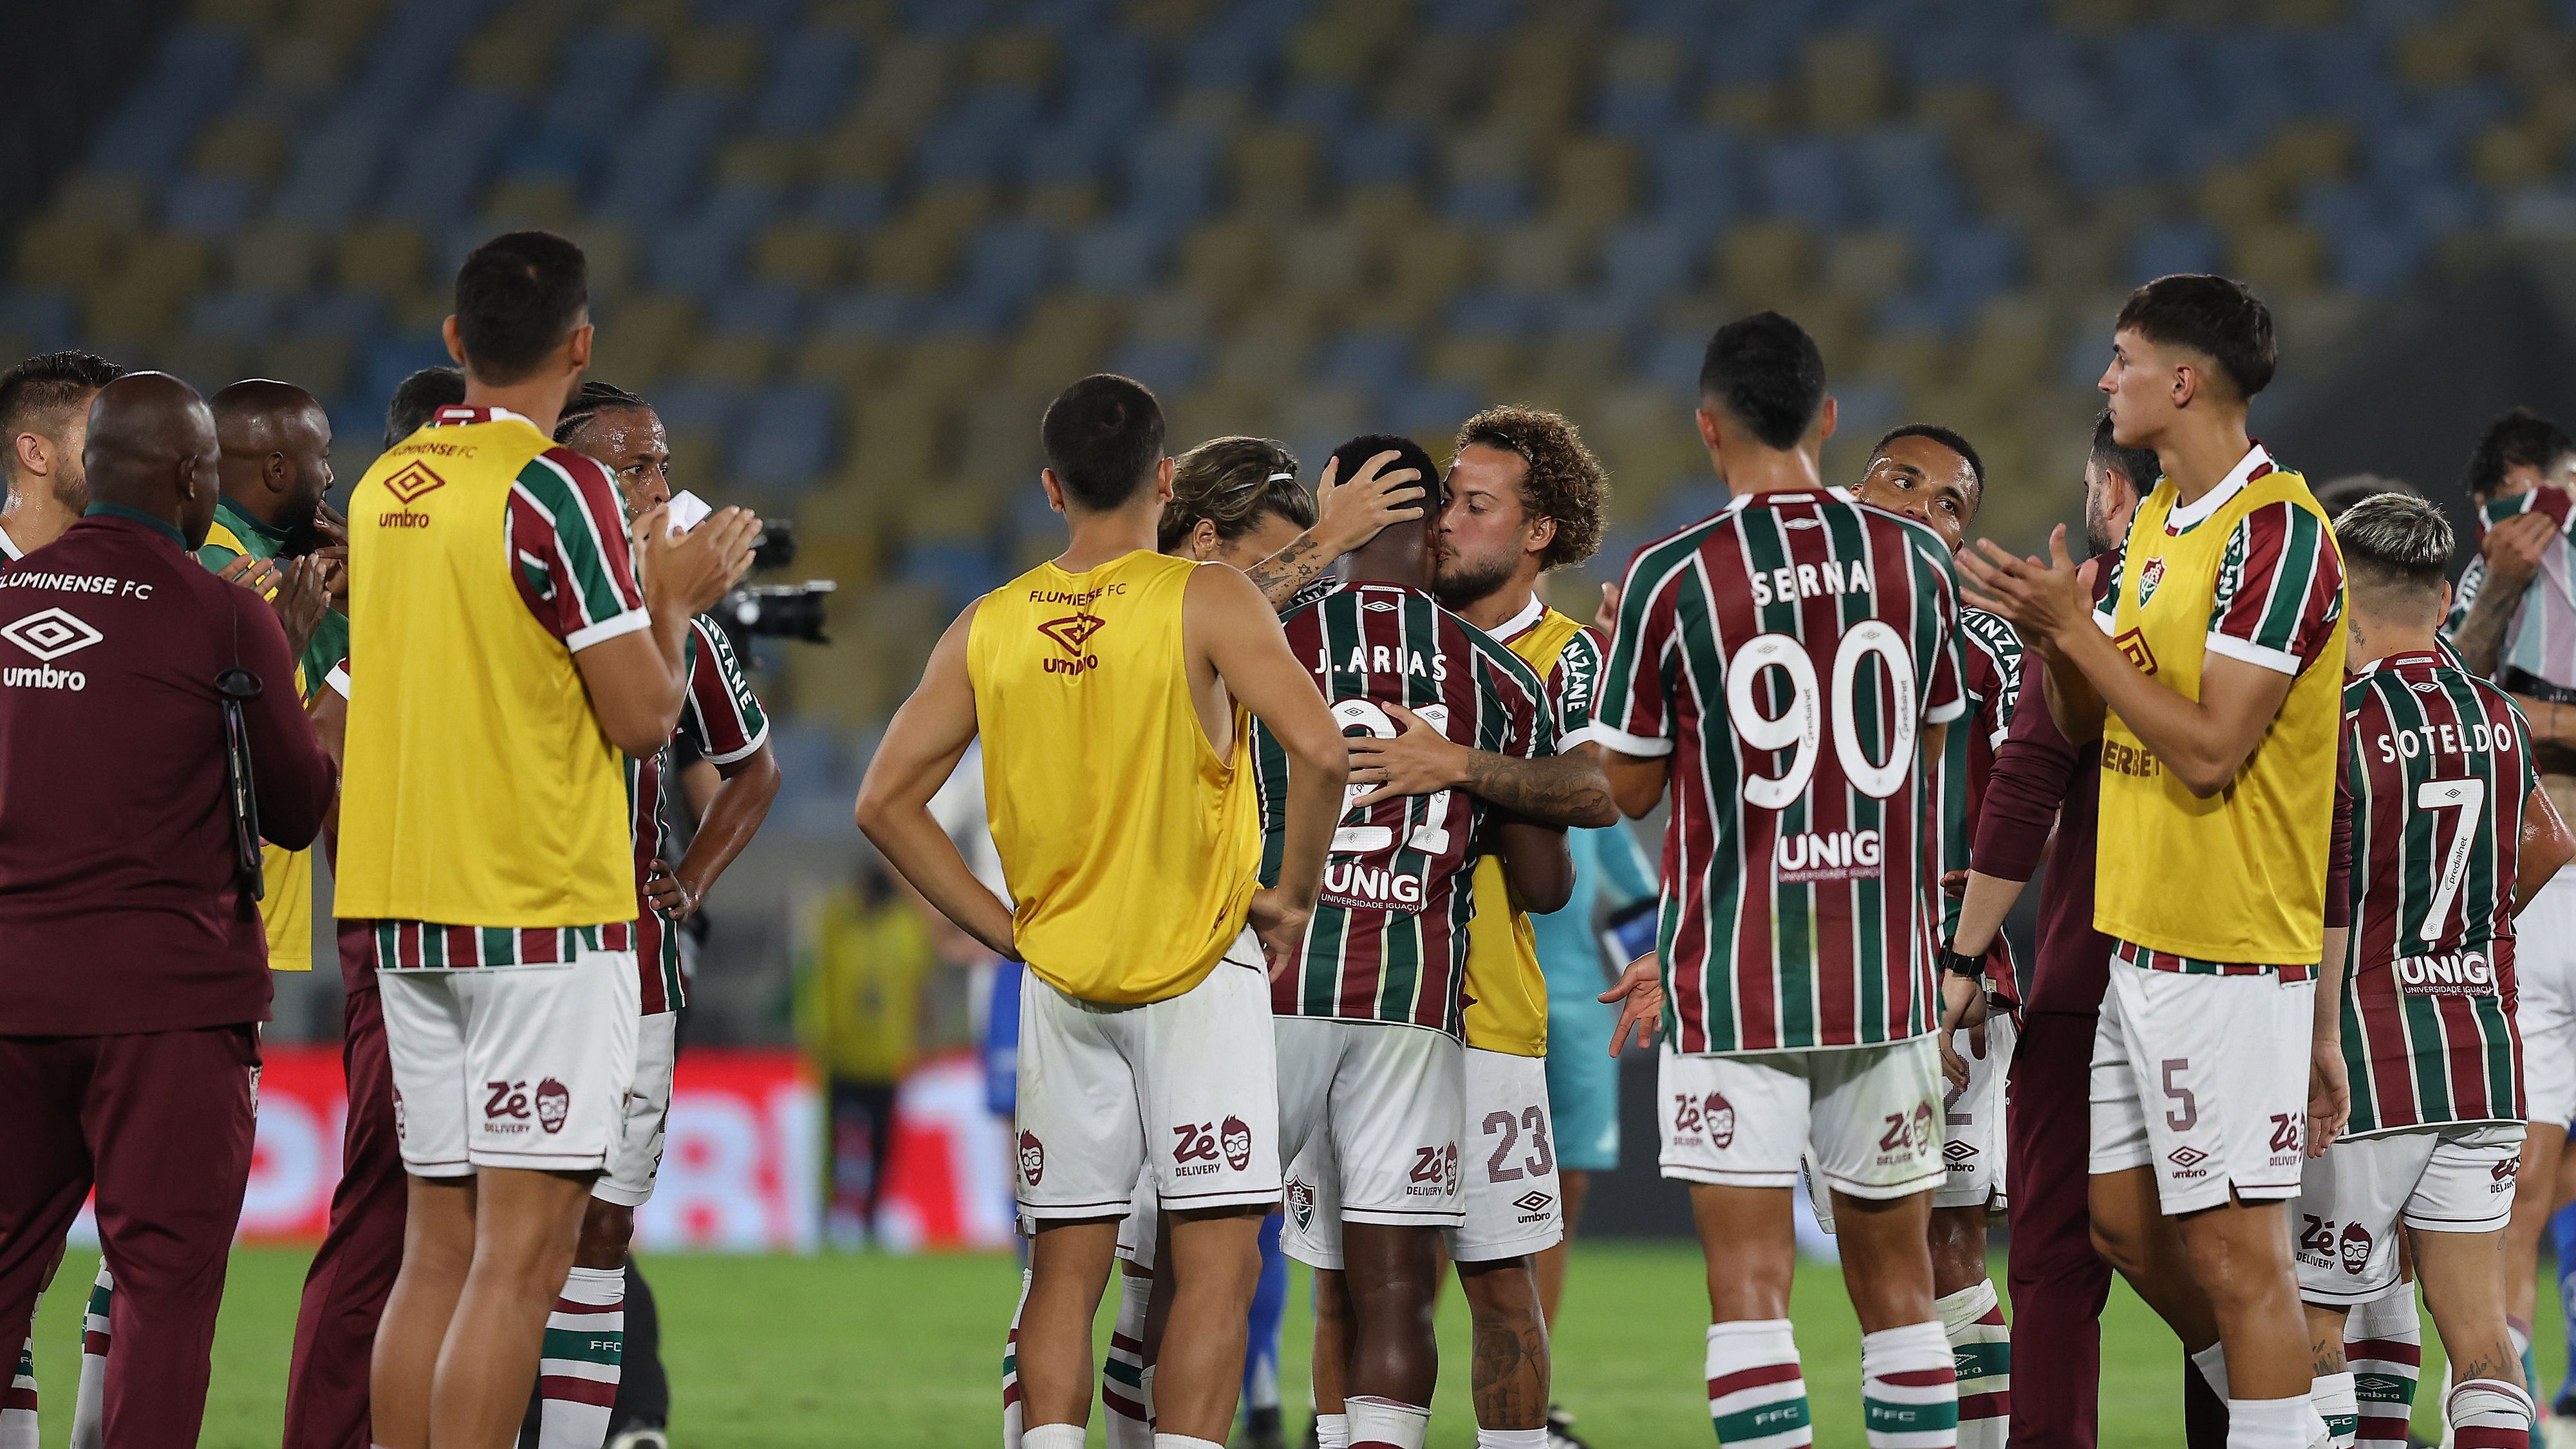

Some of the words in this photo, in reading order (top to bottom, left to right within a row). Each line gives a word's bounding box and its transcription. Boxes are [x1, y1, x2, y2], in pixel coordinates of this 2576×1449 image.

[379, 508, 429, 528] umbro
[120, 580, 153, 600] FC
[1107, 583, 1126, 596] FC
[1751, 559, 1871, 607] SERNA
[3, 663, 86, 691] umbro
[1562, 636, 1591, 713] NZANE
[1726, 619, 1918, 809] 90
[2378, 723, 2512, 763] SOTELDO
[1778, 829, 1880, 870] UNIG
[2417, 778, 2485, 941] 7
[2449, 836, 2468, 884] predialnet
[1321, 893, 1383, 909] UNIVERSIDADE
[1324, 863, 1419, 902] UNIG
[2400, 953, 2488, 984] UNIG
[2405, 986, 2461, 994] UNIVERSIDADE
[485, 1081, 531, 1119] Zé
[2161, 1058, 2197, 1132] 5
[1173, 1121, 1220, 1164] Zé
[1482, 1105, 1553, 1183] 23
[2270, 1112, 2298, 1153] Zé
[1175, 1163, 1220, 1177] DELIVERY
[1409, 1146, 1443, 1183] Zé
[1946, 1162, 1975, 1172] mbro
[2172, 1169, 2207, 1179] umbro
[1406, 1186, 1442, 1195] DELIVERY
[1518, 1212, 1550, 1224] umbro
[2300, 1213, 2336, 1257] Zé
[2296, 1251, 2335, 1270] DELIVERY
[590, 1341, 621, 1352] FFC
